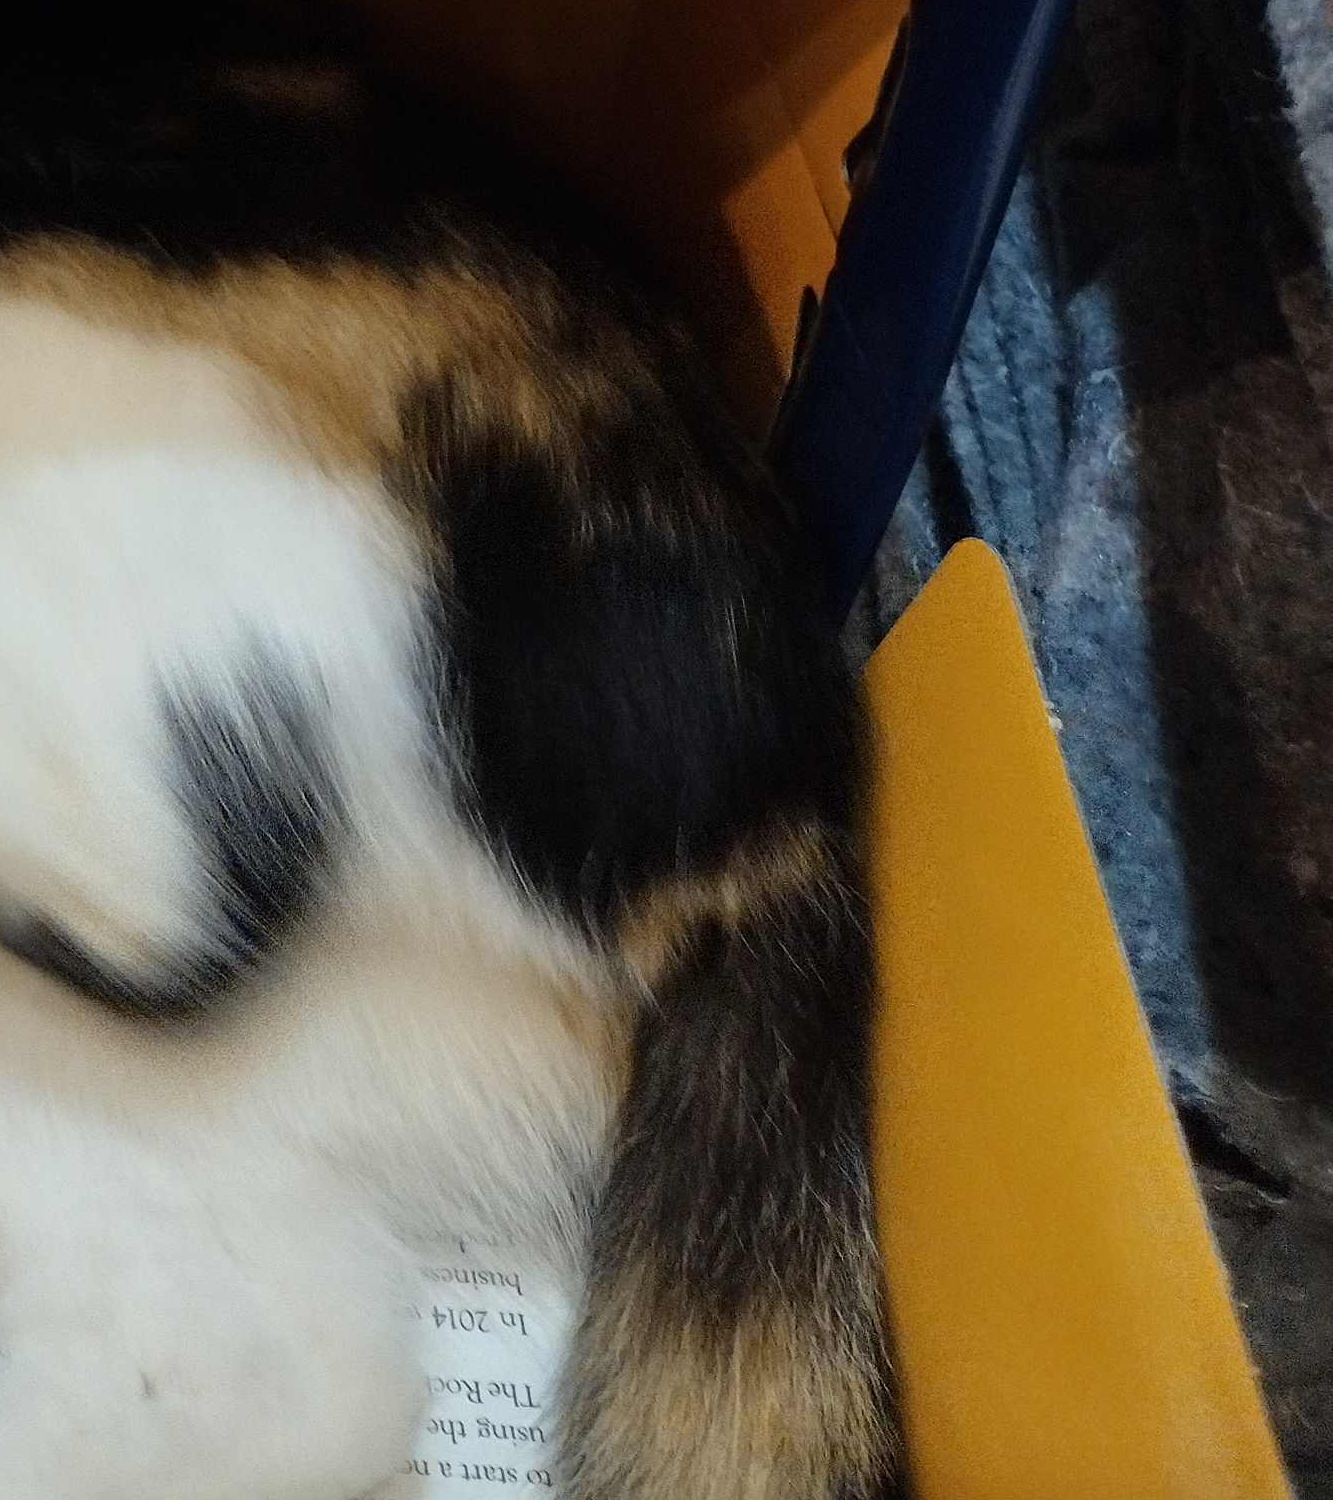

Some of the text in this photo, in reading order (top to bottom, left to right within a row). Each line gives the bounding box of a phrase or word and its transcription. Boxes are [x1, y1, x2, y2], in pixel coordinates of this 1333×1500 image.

[433, 1305, 490, 1333] 2014
[500, 1311, 529, 1336] In
[490, 1381, 542, 1408] The
[427, 1418, 466, 1445] the
[478, 1418, 546, 1446] using
[439, 1460, 452, 1476] a
[461, 1461, 517, 1484] start
[526, 1468, 553, 1487] to
